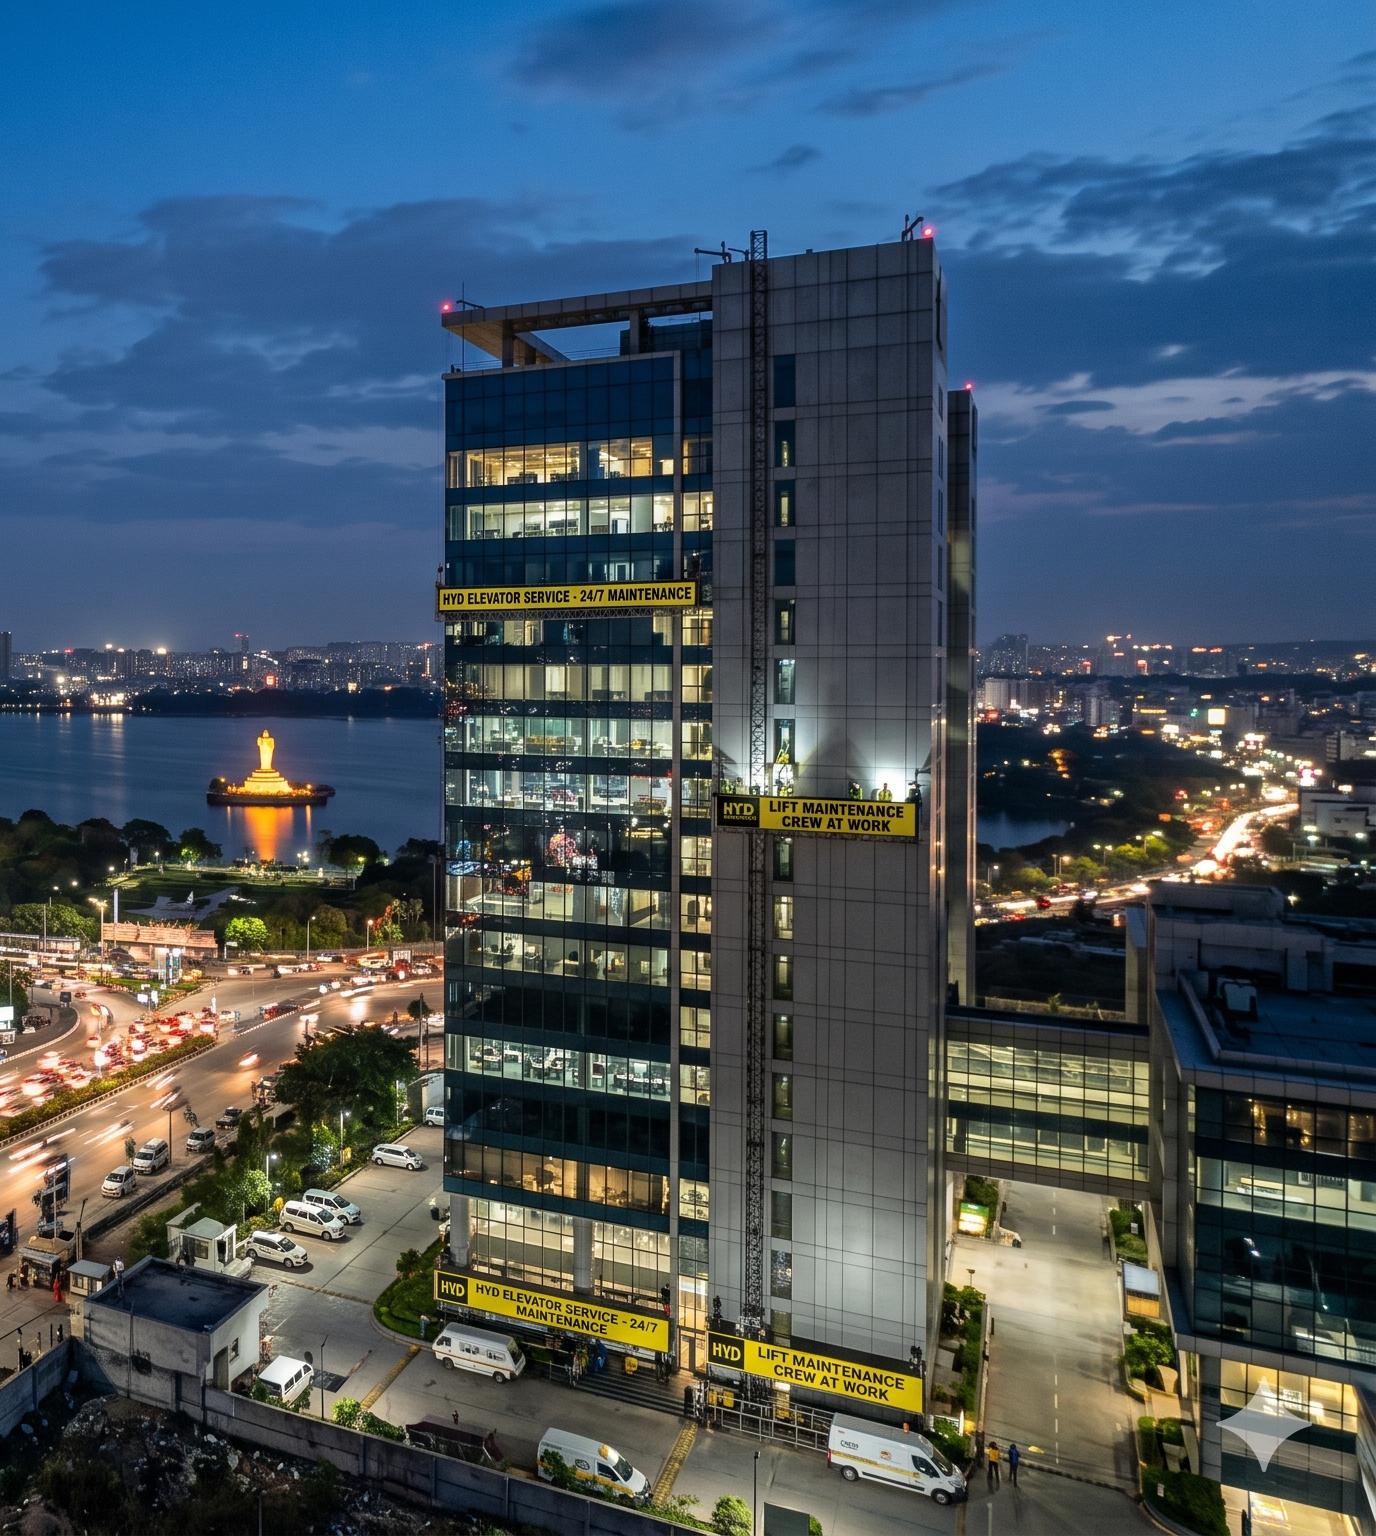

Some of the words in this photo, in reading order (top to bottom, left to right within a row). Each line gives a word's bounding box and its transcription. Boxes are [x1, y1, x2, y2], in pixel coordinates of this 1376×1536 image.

[443, 593, 464, 605] HYD
[468, 592, 520, 605] ELEVATOR
[524, 590, 570, 604] SERVICE
[580, 589, 604, 602] 24/7
[608, 587, 692, 601] MAINTENANCE
[724, 802, 754, 815] HYD
[769, 800, 798, 813] LIFT
[803, 803, 904, 818] MAINTENANCE
[782, 816, 822, 828] CREW
[827, 819, 844, 830] AT
[848, 819, 891, 832] WORK
[441, 1280, 465, 1297] HYD
[476, 1283, 500, 1297] HYD
[503, 1289, 562, 1312] ELEVATOR
[565, 1304, 618, 1325] SERVICE
[630, 1318, 658, 1333] 24/7
[516, 1305, 607, 1334] MAINTENANCE
[712, 1342, 741, 1361] HYD
[758, 1346, 789, 1363] LIFT
[793, 1354, 905, 1390] MAINTENANCE
[774, 1365, 817, 1384] CREW
[820, 1376, 840, 1389] AT
[843, 1380, 889, 1401] WORK
